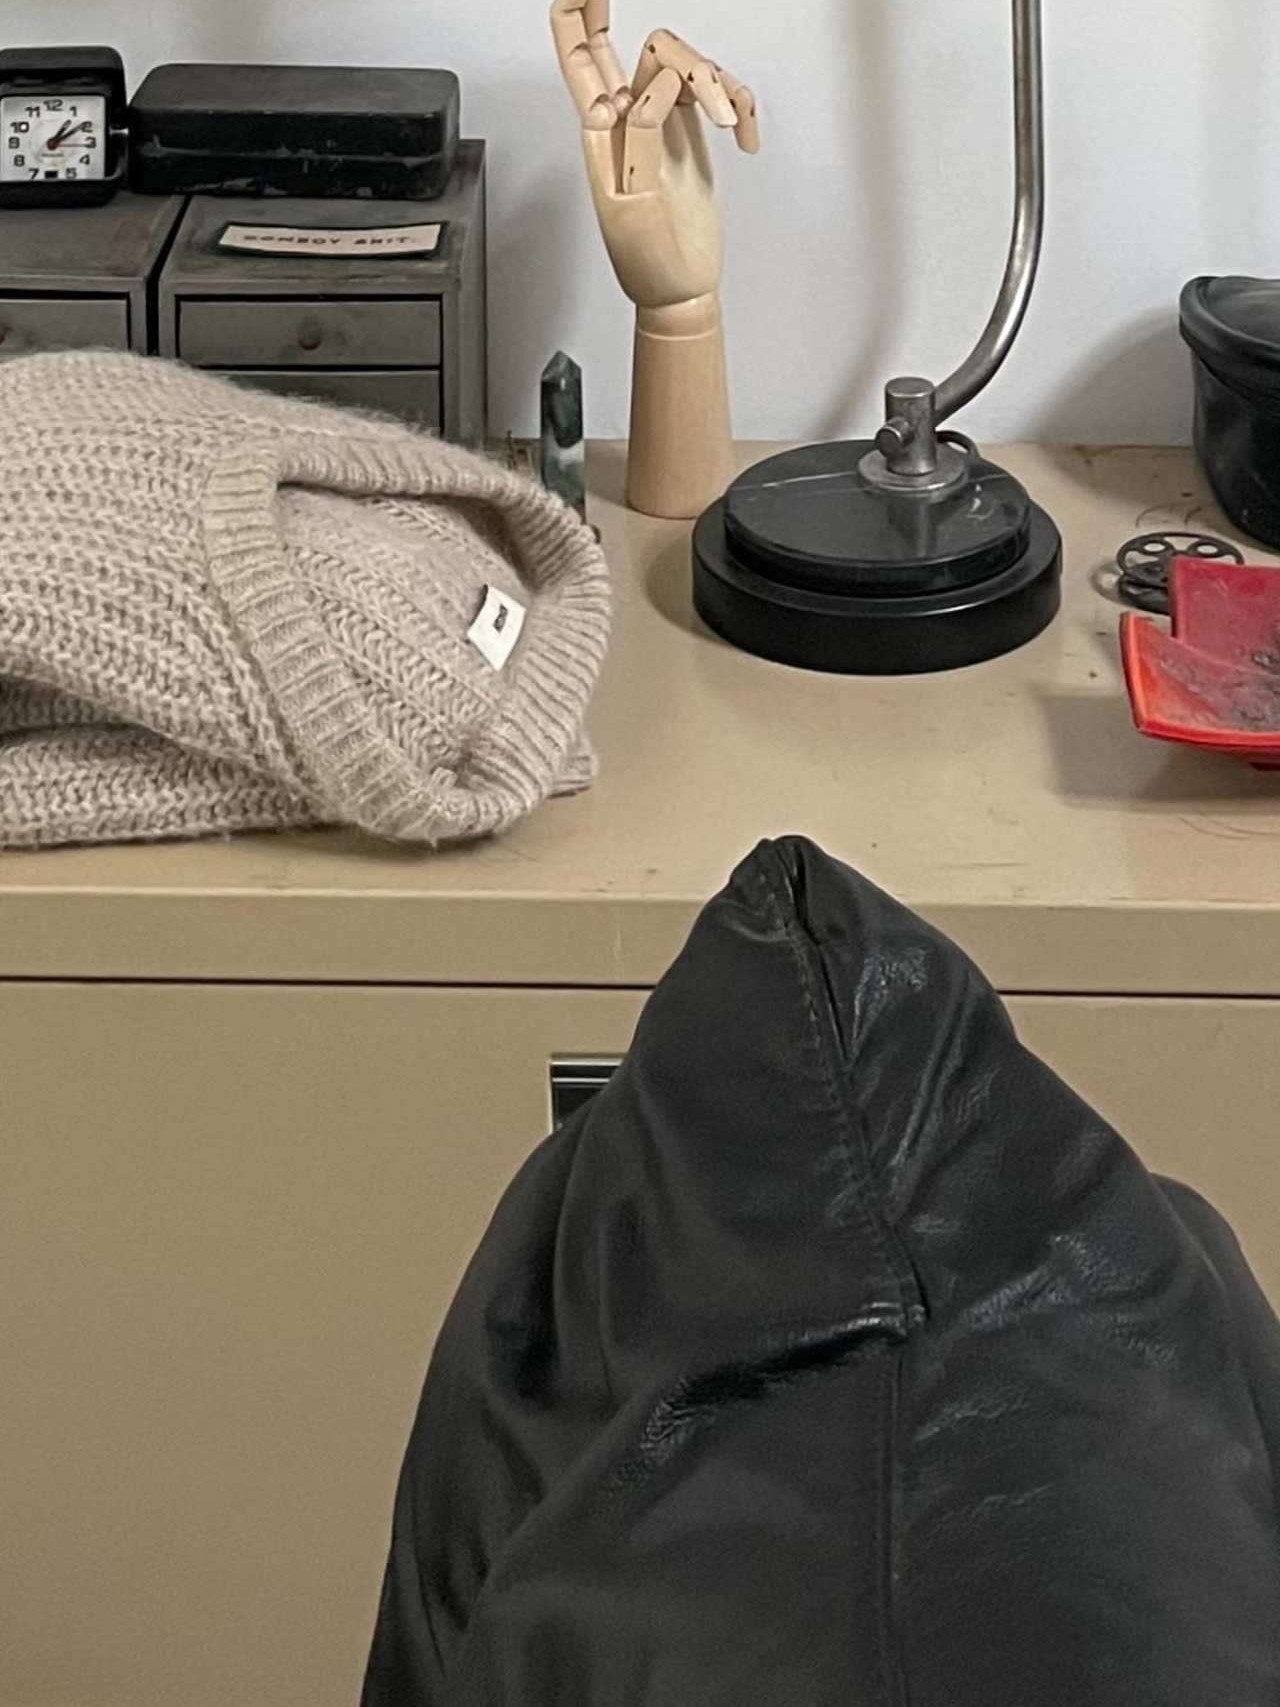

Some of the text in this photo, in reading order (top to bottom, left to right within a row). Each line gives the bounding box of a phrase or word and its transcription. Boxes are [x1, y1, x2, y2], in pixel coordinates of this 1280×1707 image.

[44, 99, 63, 111] 12
[25, 106, 40, 118] 11
[69, 106, 77, 117] 1
[10, 121, 29, 133] 10
[8, 136, 20, 149] 9
[85, 136, 96, 149] 3
[14, 154, 25, 167] 8
[79, 154, 91, 165] 4
[28, 168, 39, 179] 7
[65, 168, 77, 179] 5
